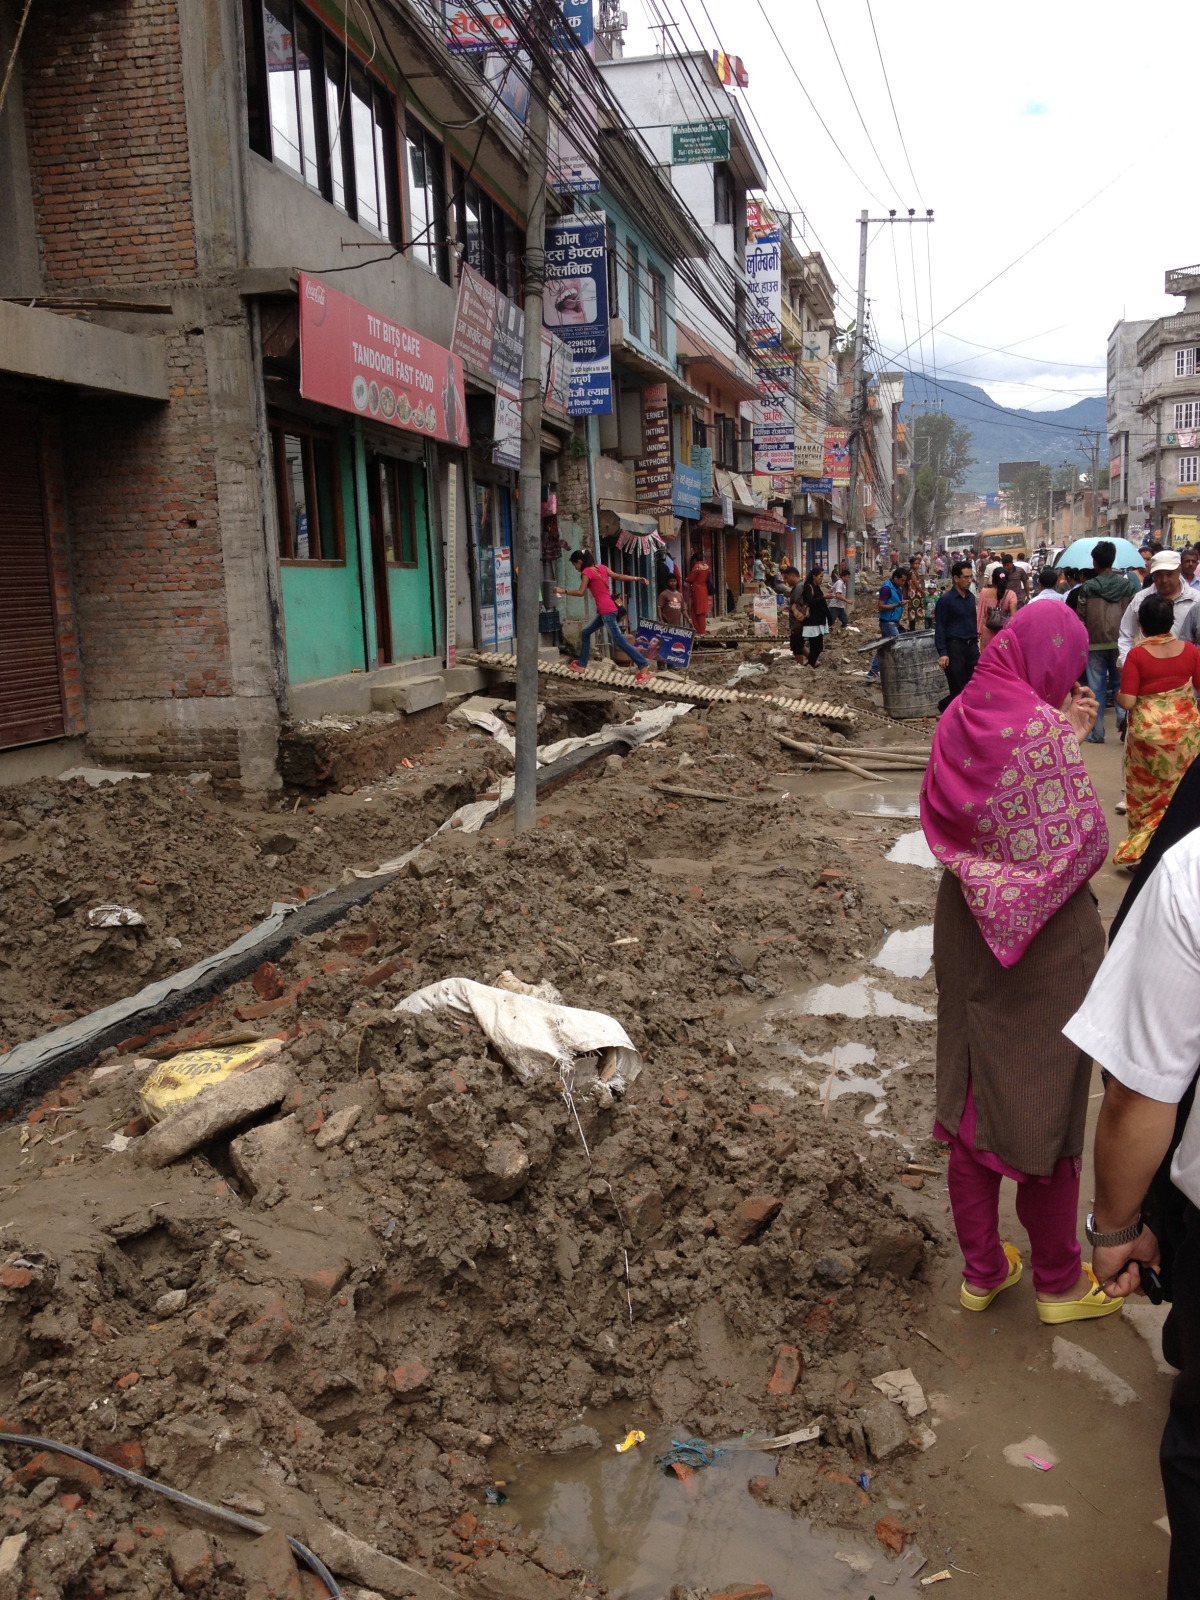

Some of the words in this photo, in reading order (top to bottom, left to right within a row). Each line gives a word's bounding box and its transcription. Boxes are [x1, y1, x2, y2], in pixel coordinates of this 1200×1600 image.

[555, 232, 580, 246] ओम्
[568, 246, 604, 260] डेण्टल
[746, 247, 778, 278] लुम्बिनी
[762, 280, 778, 294] हाउस
[368, 314, 381, 339] TIT
[382, 322, 400, 348] BITS
[402, 332, 420, 358] CAFE
[394, 347, 398, 358] &
[352, 342, 394, 377] TANDOORI
[396, 359, 414, 384] FAST
[416, 369, 434, 393] FOOD
[646, 410, 664, 420] ERNET
[646, 426, 664, 436] INTING
[638, 456, 668, 468] NETPHONE
[637, 476, 646, 485] AIR
[646, 474, 668, 484] TECKET
